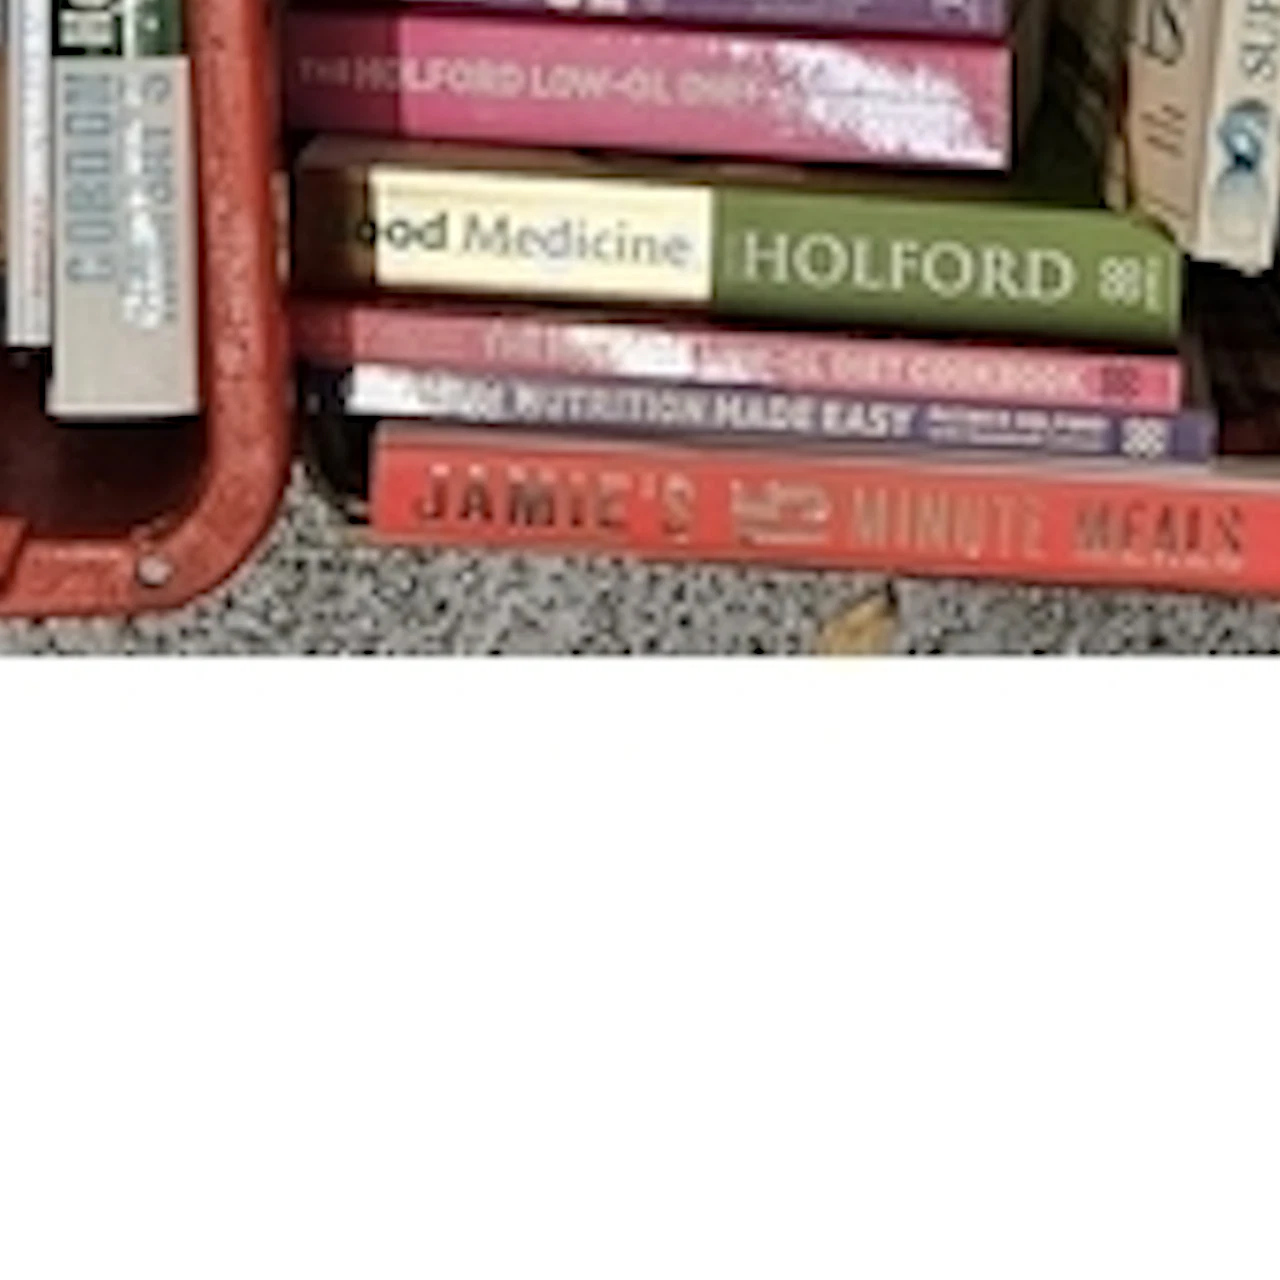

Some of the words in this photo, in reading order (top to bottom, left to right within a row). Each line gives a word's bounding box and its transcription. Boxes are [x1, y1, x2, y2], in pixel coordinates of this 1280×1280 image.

[354, 61, 524, 104] HOLFORD
[528, 64, 670, 109] LOW-GL
[459, 210, 695, 271] Medicine
[741, 232, 1078, 303] HOLFORD
[516, 386, 703, 423] NUTRITION
[717, 390, 813, 432] MADE
[820, 398, 915, 438] EASY
[414, 462, 695, 544] JAMIE'S
[854, 480, 1046, 564] MINUTE
[1074, 496, 1245, 574] MEALS
